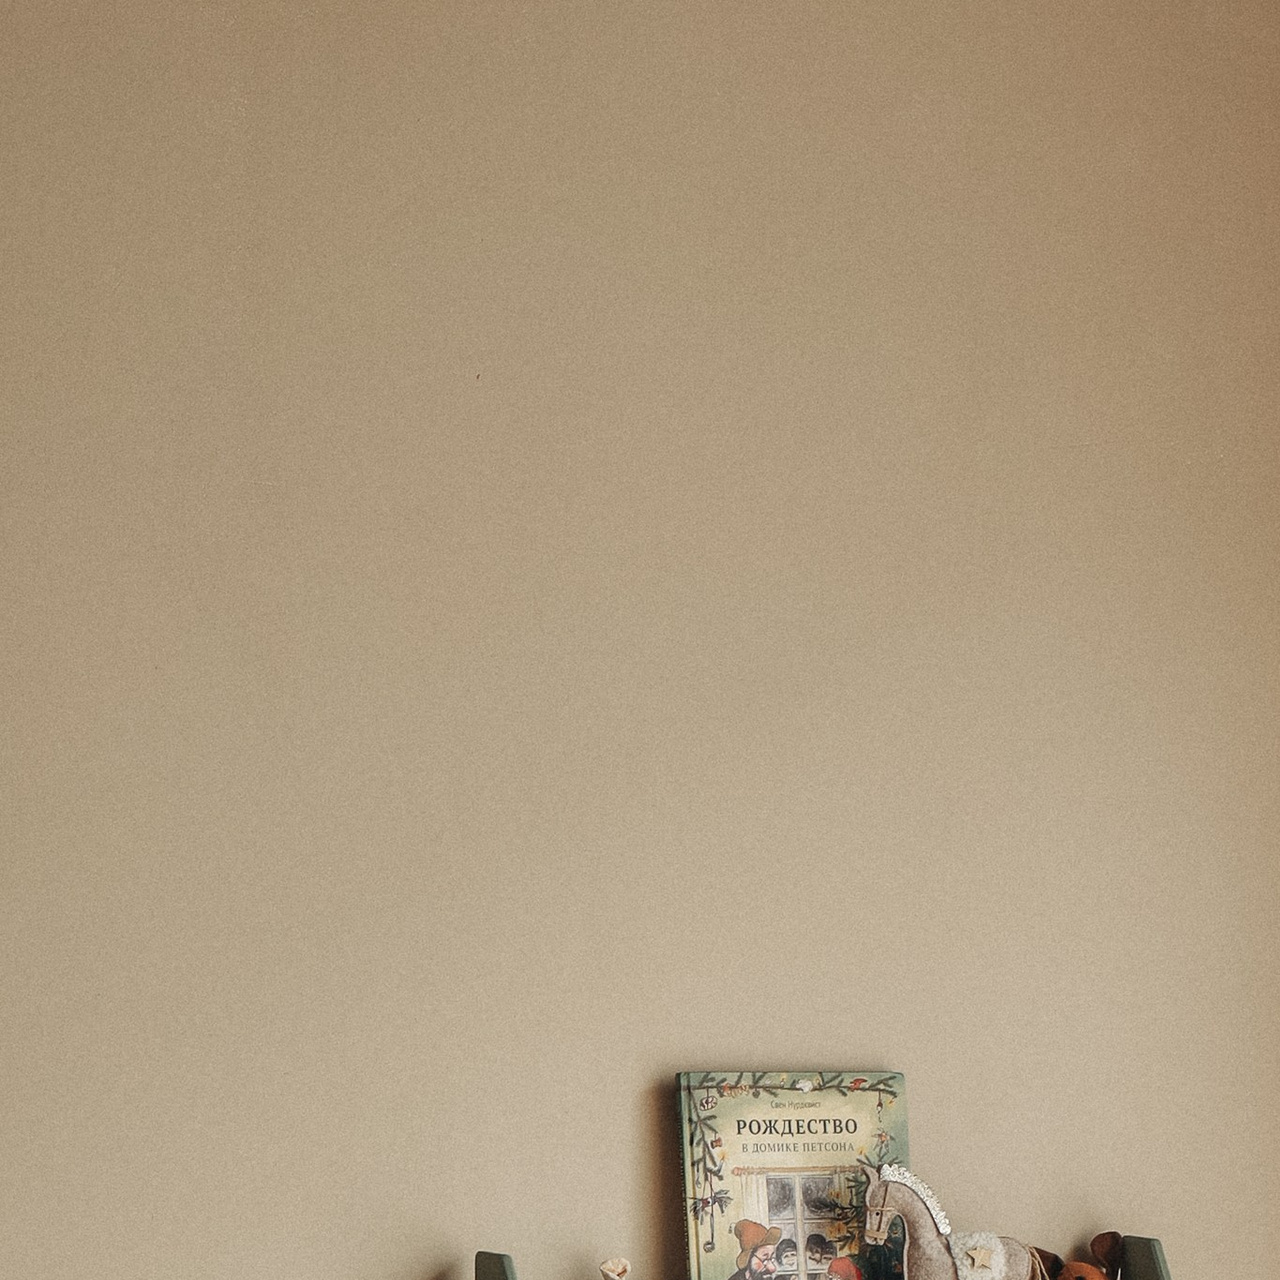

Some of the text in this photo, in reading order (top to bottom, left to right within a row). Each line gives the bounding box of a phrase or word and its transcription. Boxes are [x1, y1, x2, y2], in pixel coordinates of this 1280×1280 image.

[736, 1118, 858, 1137] РОЖДЕСТВО
[742, 1141, 855, 1154] В ДОМИКЕ ПЕТСОНА
